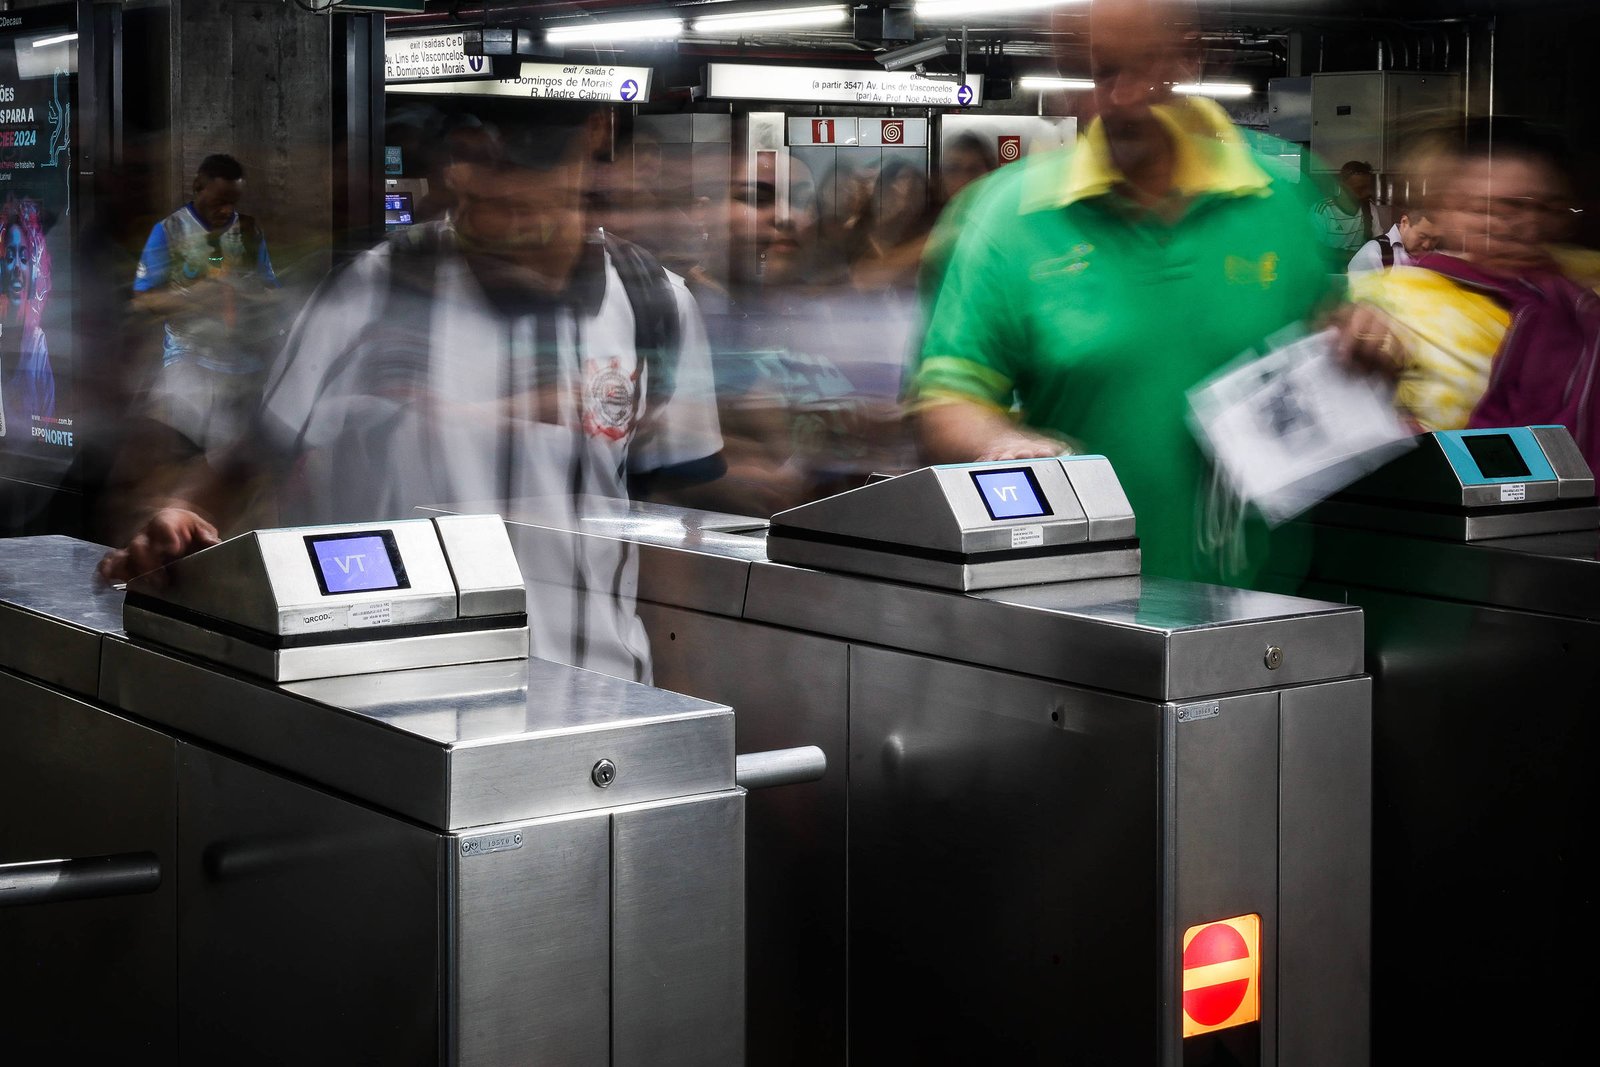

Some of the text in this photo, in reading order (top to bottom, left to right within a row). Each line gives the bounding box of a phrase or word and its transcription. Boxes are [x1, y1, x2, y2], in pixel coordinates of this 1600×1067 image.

[410, 41, 421, 50] exit
[447, 37, 451, 47] C
[458, 36, 462, 46] D
[395, 51, 409, 64] Lins
[411, 51, 420, 63] de
[421, 50, 464, 62] Vasconcelos
[387, 62, 465, 78] R. Domingos de Morais
[563, 66, 577, 75] exit
[608, 67, 615, 77] C
[514, 75, 563, 88] Domingos
[565, 77, 579, 87] de
[581, 77, 613, 88] Morais
[812, 80, 953, 94] (a partir 3547) Av. Lins de Vasconcelos
[530, 87, 612, 100] R. Madre Cabrini
[856, 92, 872, 102] (par)
[922, 95, 952, 105] Azevedo
[6, 108, 27, 123] PARA
[28, 107, 35, 122] A
[45, 429, 72, 446] NORTE
[993, 485, 1018, 502] VT
[333, 554, 366, 574] VT
